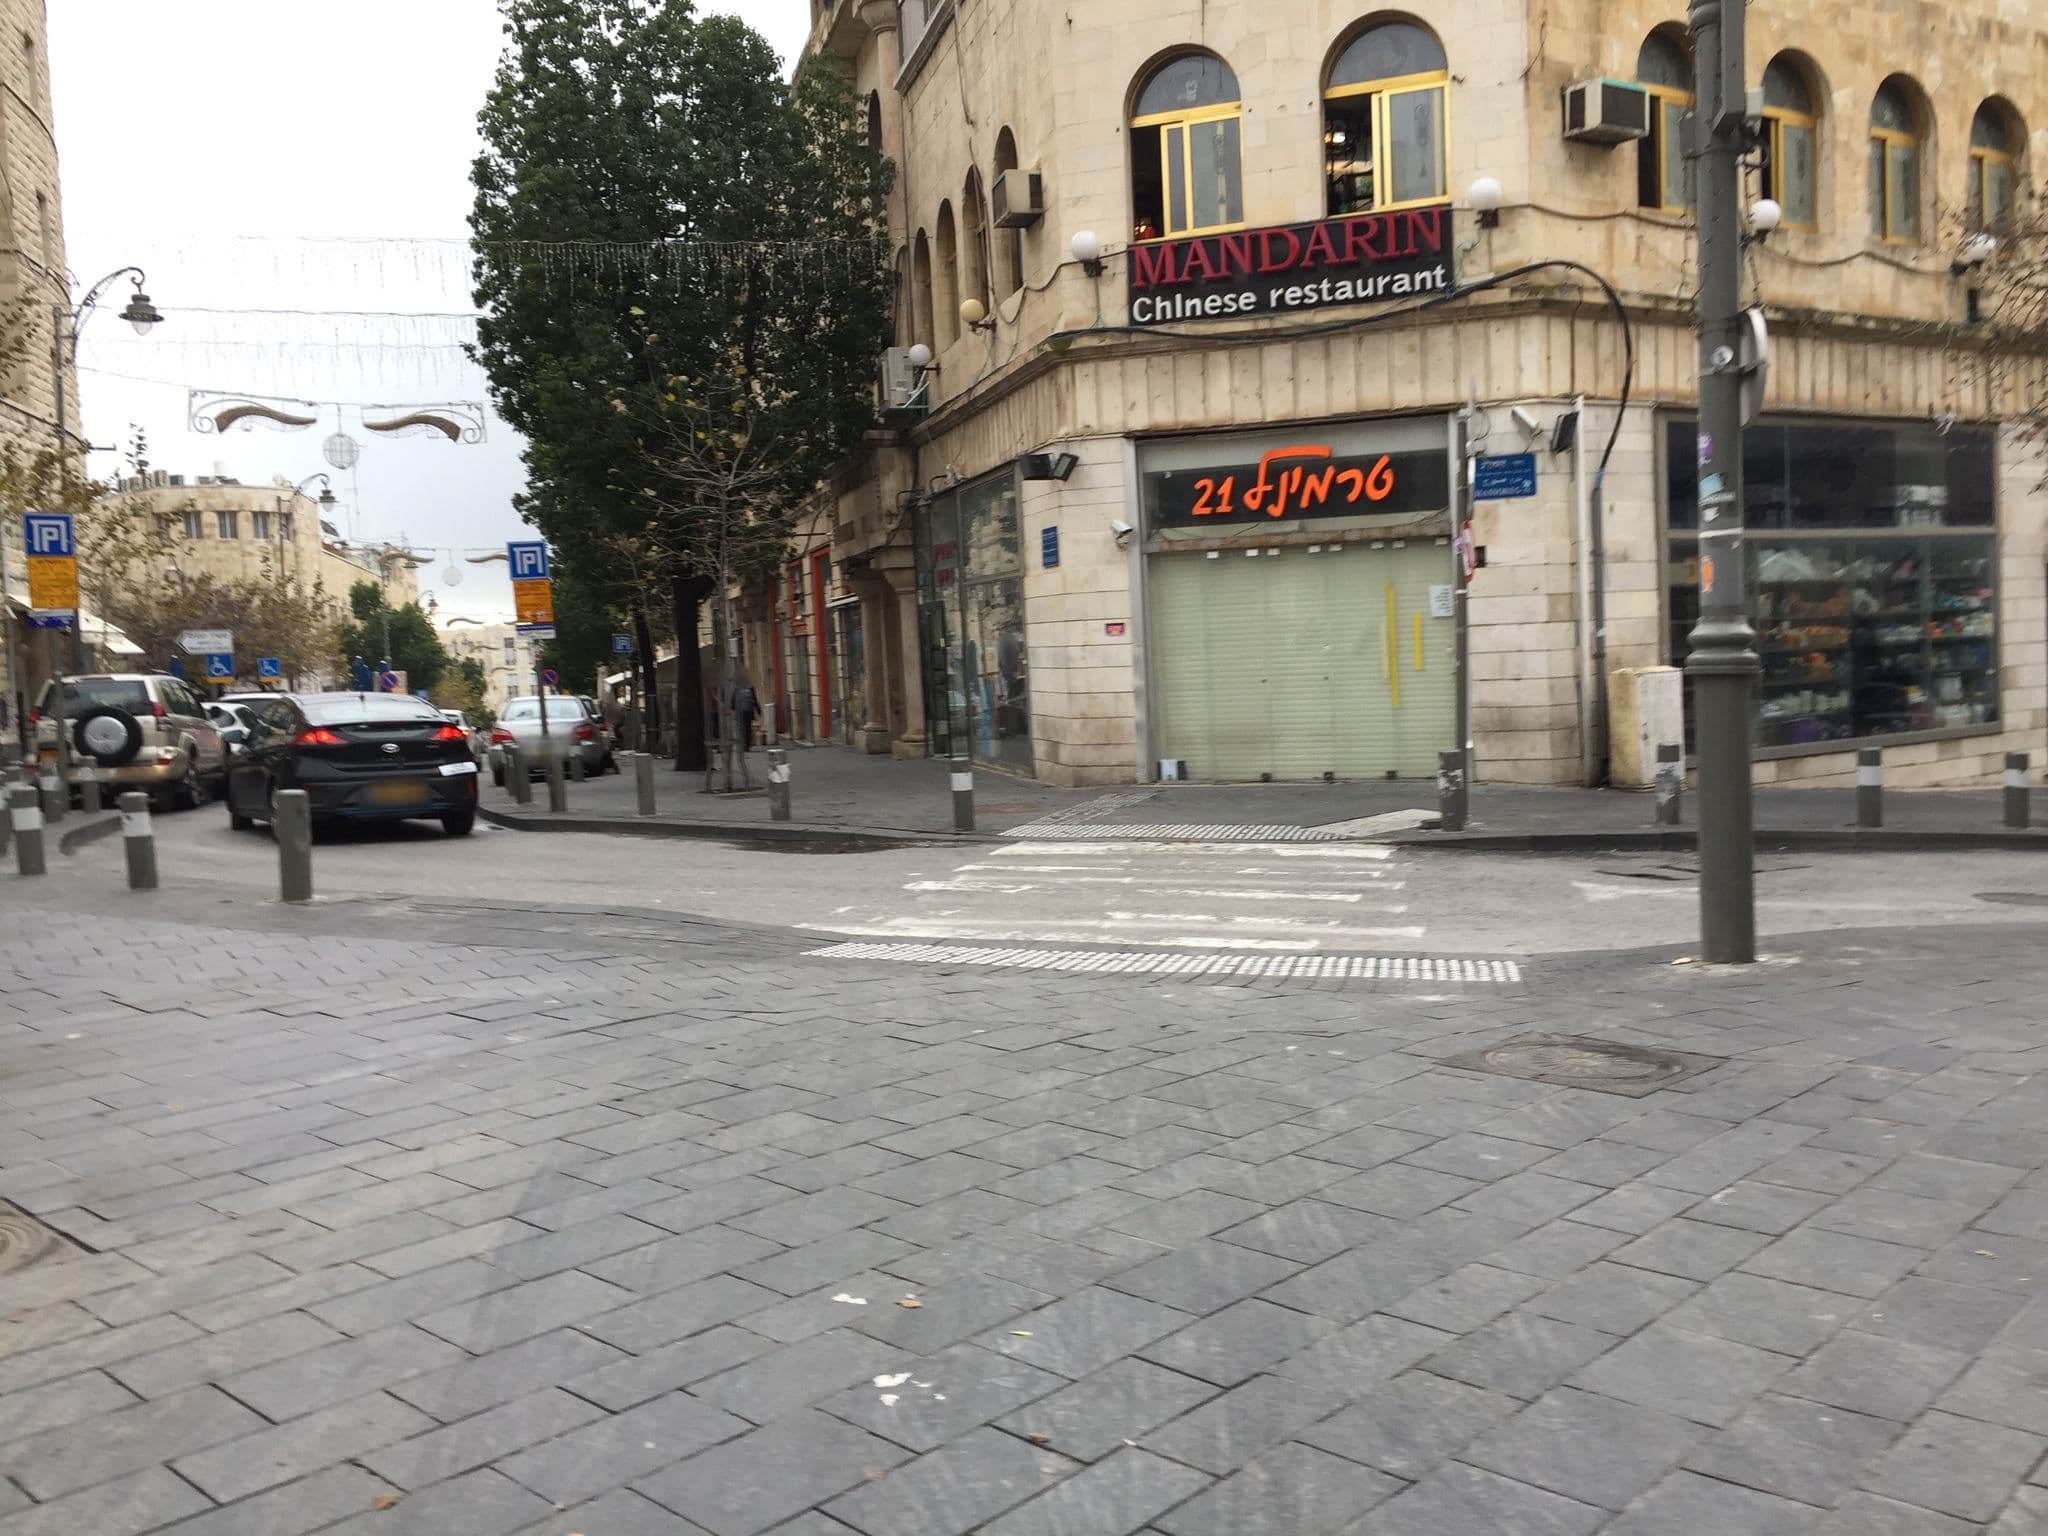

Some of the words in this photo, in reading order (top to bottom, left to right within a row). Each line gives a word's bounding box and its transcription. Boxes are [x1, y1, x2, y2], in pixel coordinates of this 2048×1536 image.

[1132, 208, 1444, 287] MANDARIN
[1269, 264, 1448, 308] restaurant
[1191, 475, 1236, 516] 21
[1243, 444, 1395, 517] טרמינל
